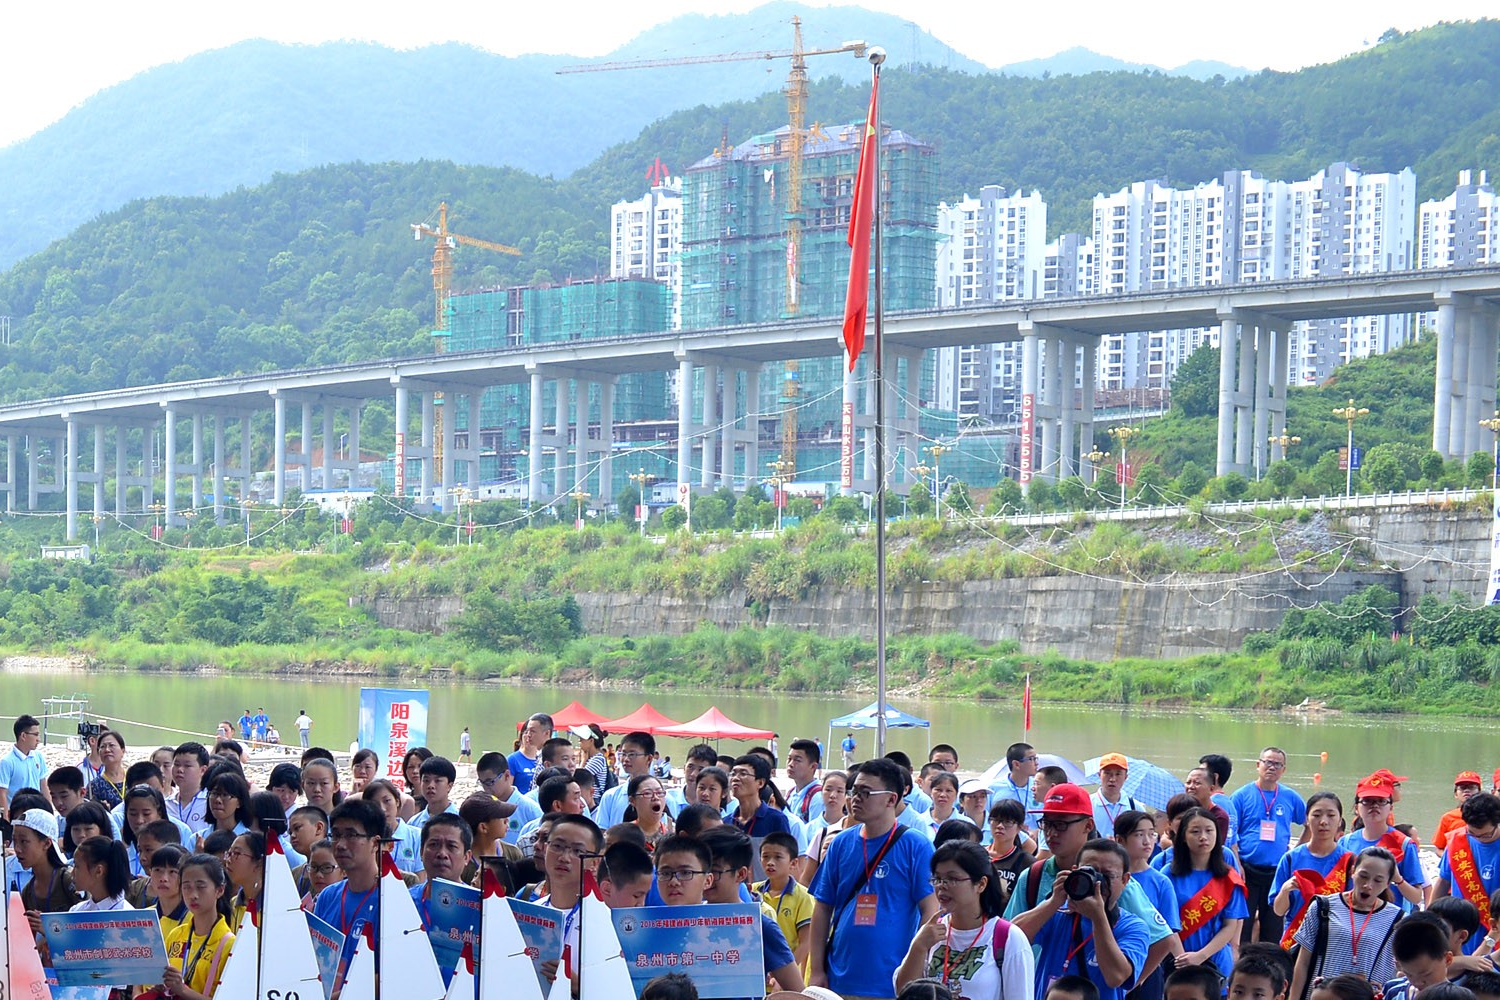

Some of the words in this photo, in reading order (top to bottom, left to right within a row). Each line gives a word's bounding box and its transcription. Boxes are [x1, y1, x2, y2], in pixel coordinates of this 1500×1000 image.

[1021, 395, 1032, 481] 6515555
[636, 950, 741, 967] 泉州市第一中学
